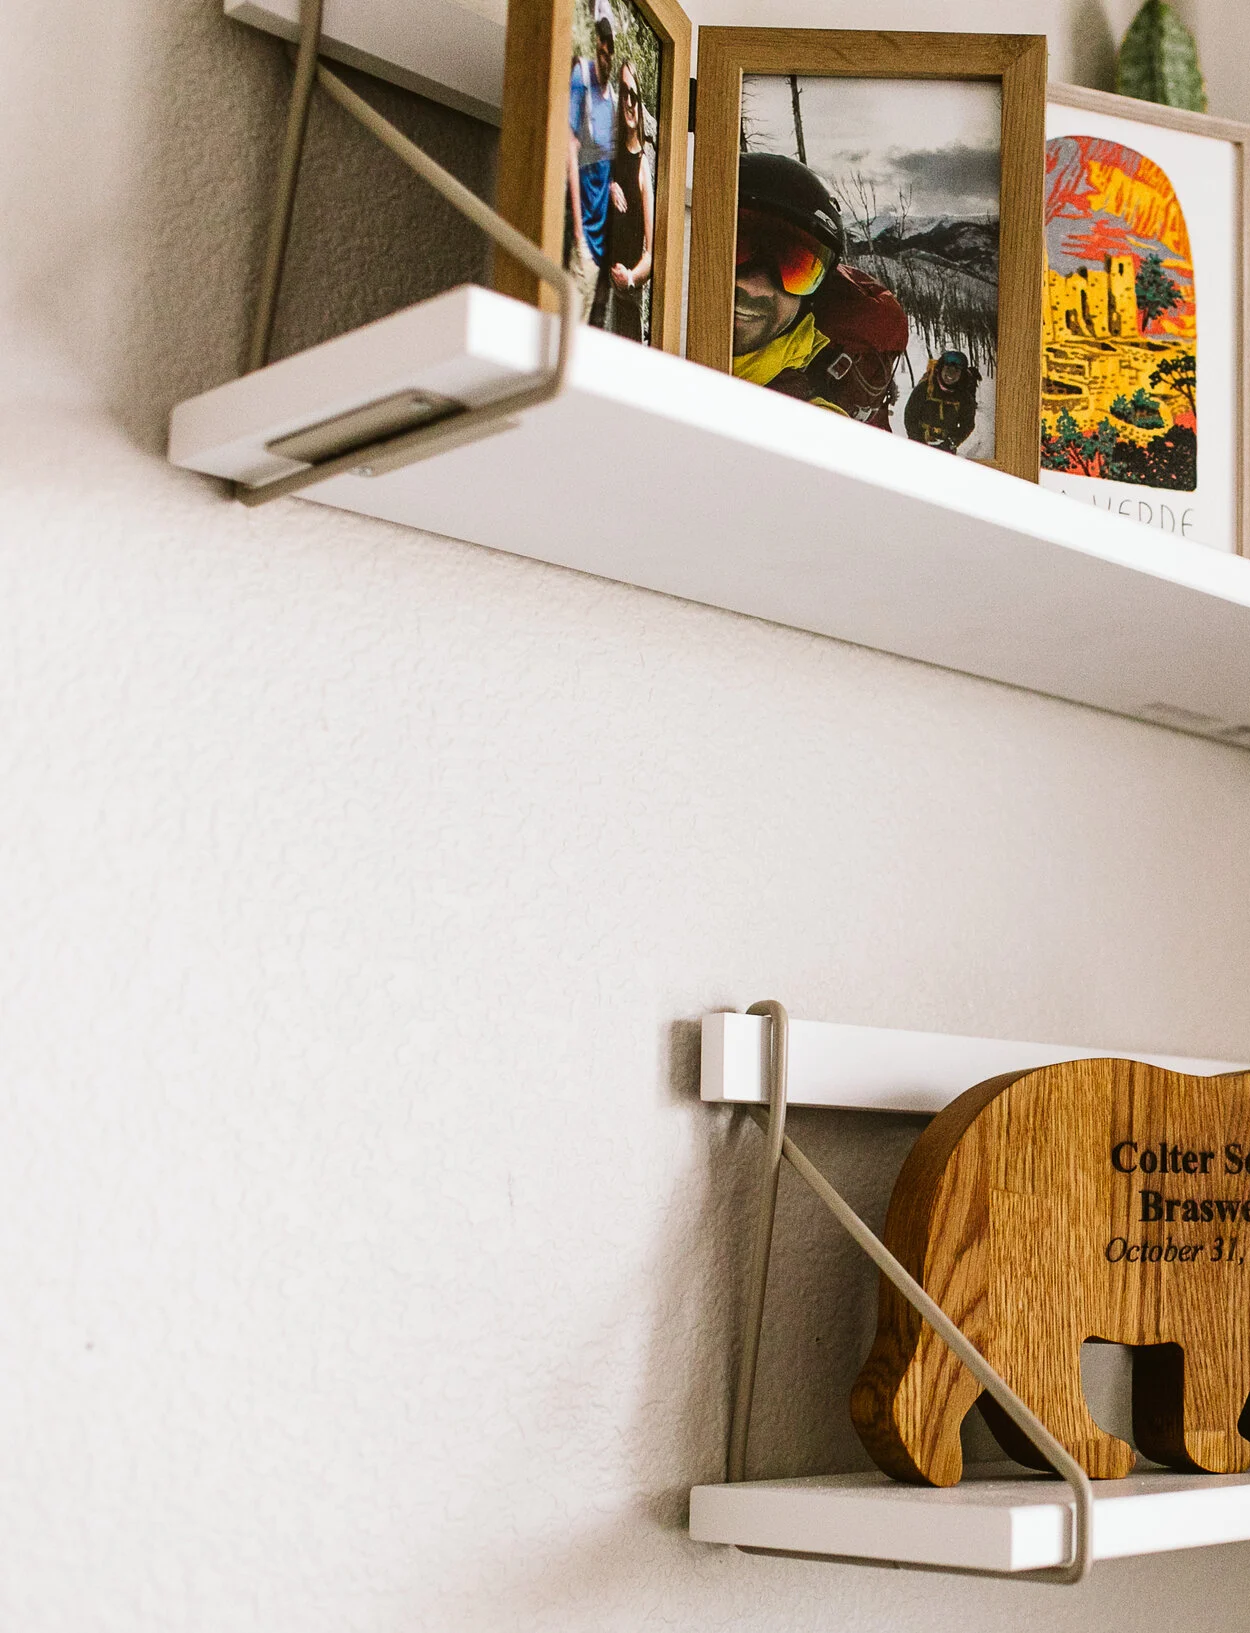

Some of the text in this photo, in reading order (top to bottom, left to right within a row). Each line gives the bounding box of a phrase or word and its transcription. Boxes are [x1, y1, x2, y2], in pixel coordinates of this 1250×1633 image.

[1111, 1141, 1214, 1174] Colter
[1105, 1237, 1203, 1262] October
[1211, 1237, 1244, 1265] 31,
